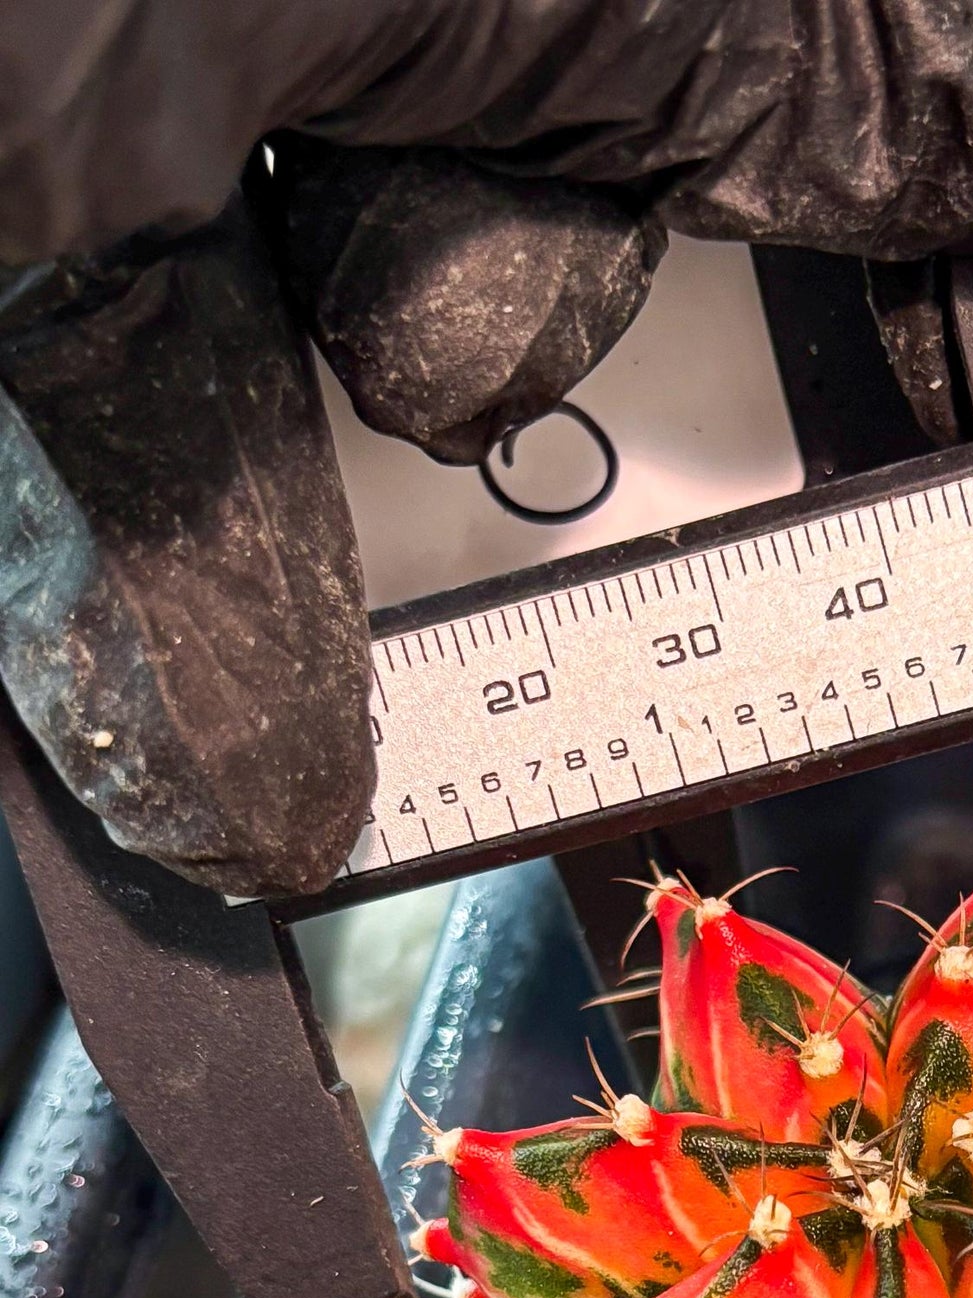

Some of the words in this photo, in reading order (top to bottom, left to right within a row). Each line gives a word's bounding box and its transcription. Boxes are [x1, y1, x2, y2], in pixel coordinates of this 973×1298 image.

[483, 669, 552, 716] 20
[652, 623, 723, 669] 30
[824, 577, 890, 622] 40
[399, 794, 417, 815] 4
[437, 783, 459, 805] 5
[480, 771, 501, 793] 6
[525, 760, 542, 781] 7
[564, 748, 587, 771] 8
[607, 738, 629, 761] 9
[644, 703, 664, 735] 1
[701, 715, 713, 735] 1
[734, 703, 756, 725] 2
[777, 691, 798, 713] 3
[821, 680, 839, 701] 4
[861, 668, 882, 690] 5
[904, 656, 925, 679] 6
[950, 644, 968, 665] 7
